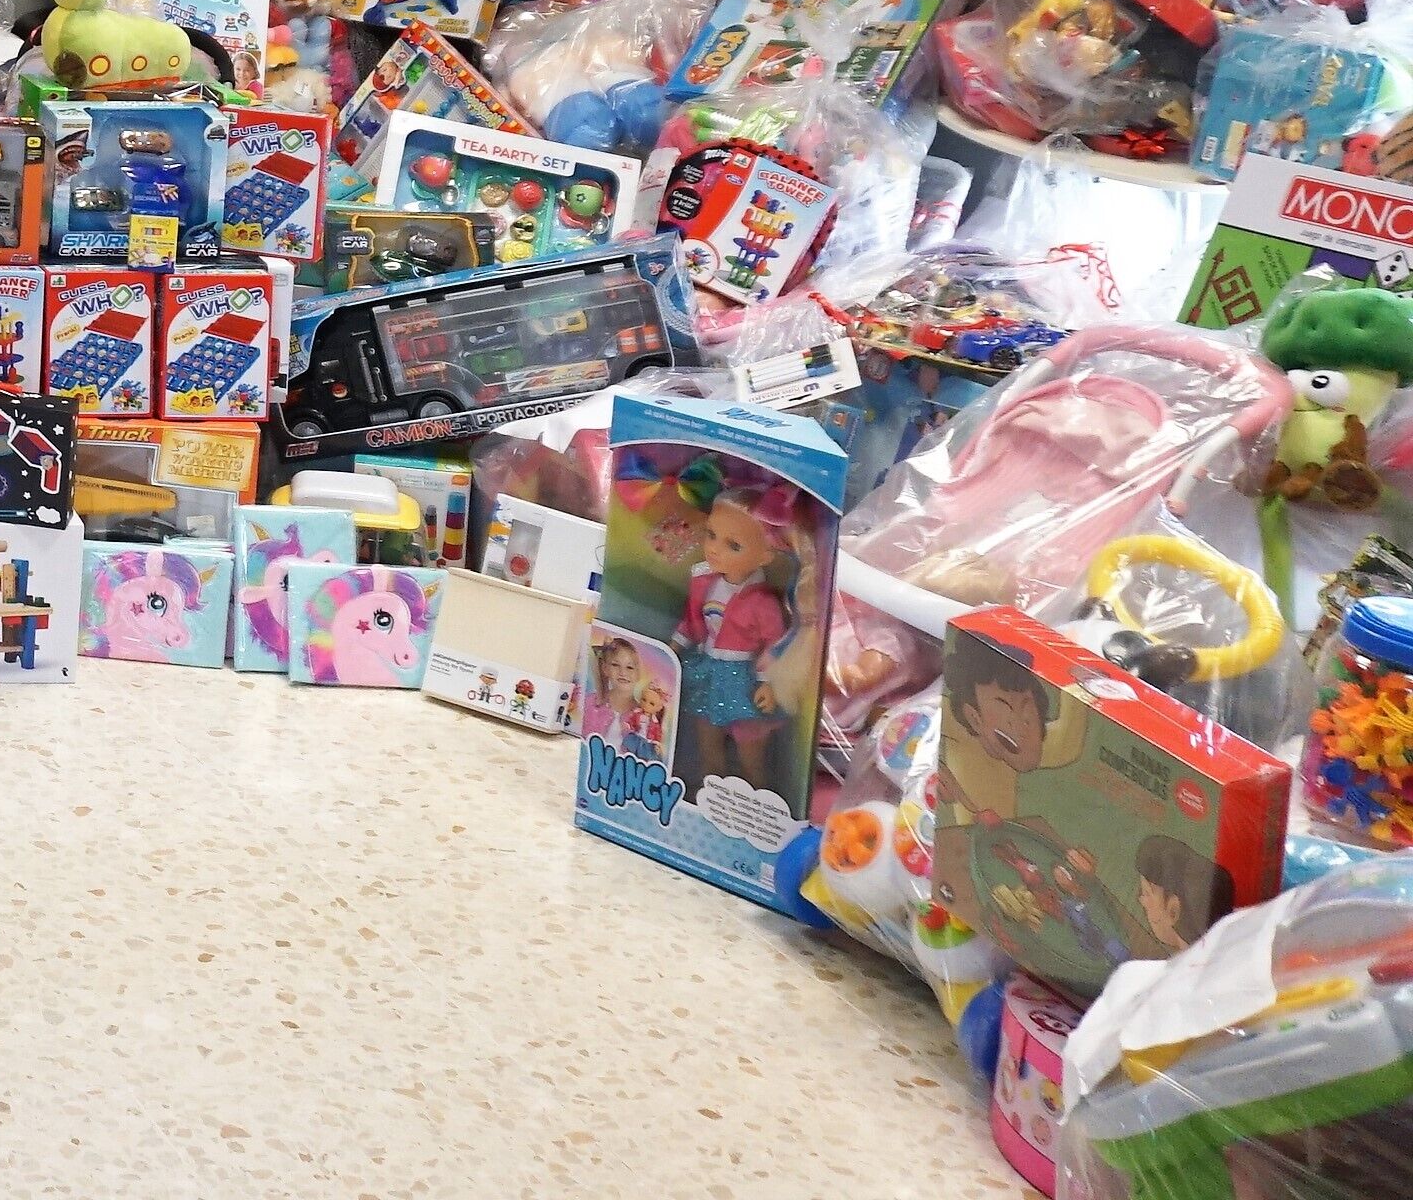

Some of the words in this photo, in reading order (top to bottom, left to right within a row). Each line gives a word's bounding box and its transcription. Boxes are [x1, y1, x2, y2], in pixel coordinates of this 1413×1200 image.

[230, 123, 278, 138] GUESS
[242, 128, 317, 156] WHO?
[460, 137, 488, 155] TEA
[492, 145, 539, 164] PARTY
[541, 155, 571, 172] SET
[758, 169, 827, 203] BALANCE
[767, 180, 812, 207] TOWER
[186, 242, 219, 250] METAL
[341, 240, 369, 249] CAR
[342, 235, 368, 243] METAL
[58, 247, 88, 256] CAR
[185, 249, 219, 258] CAR
[59, 281, 108, 302] GUESS
[72, 284, 145, 317] WHO?
[177, 284, 226, 304] GUESS
[1213, 266, 1263, 326] GO
[190, 288, 265, 321] WHO?
[475, 397, 587, 427] PORTACOCHE
[91, 426, 154, 442] Truck
[171, 436, 245, 458] POWER
[588, 734, 684, 827] NANCY
